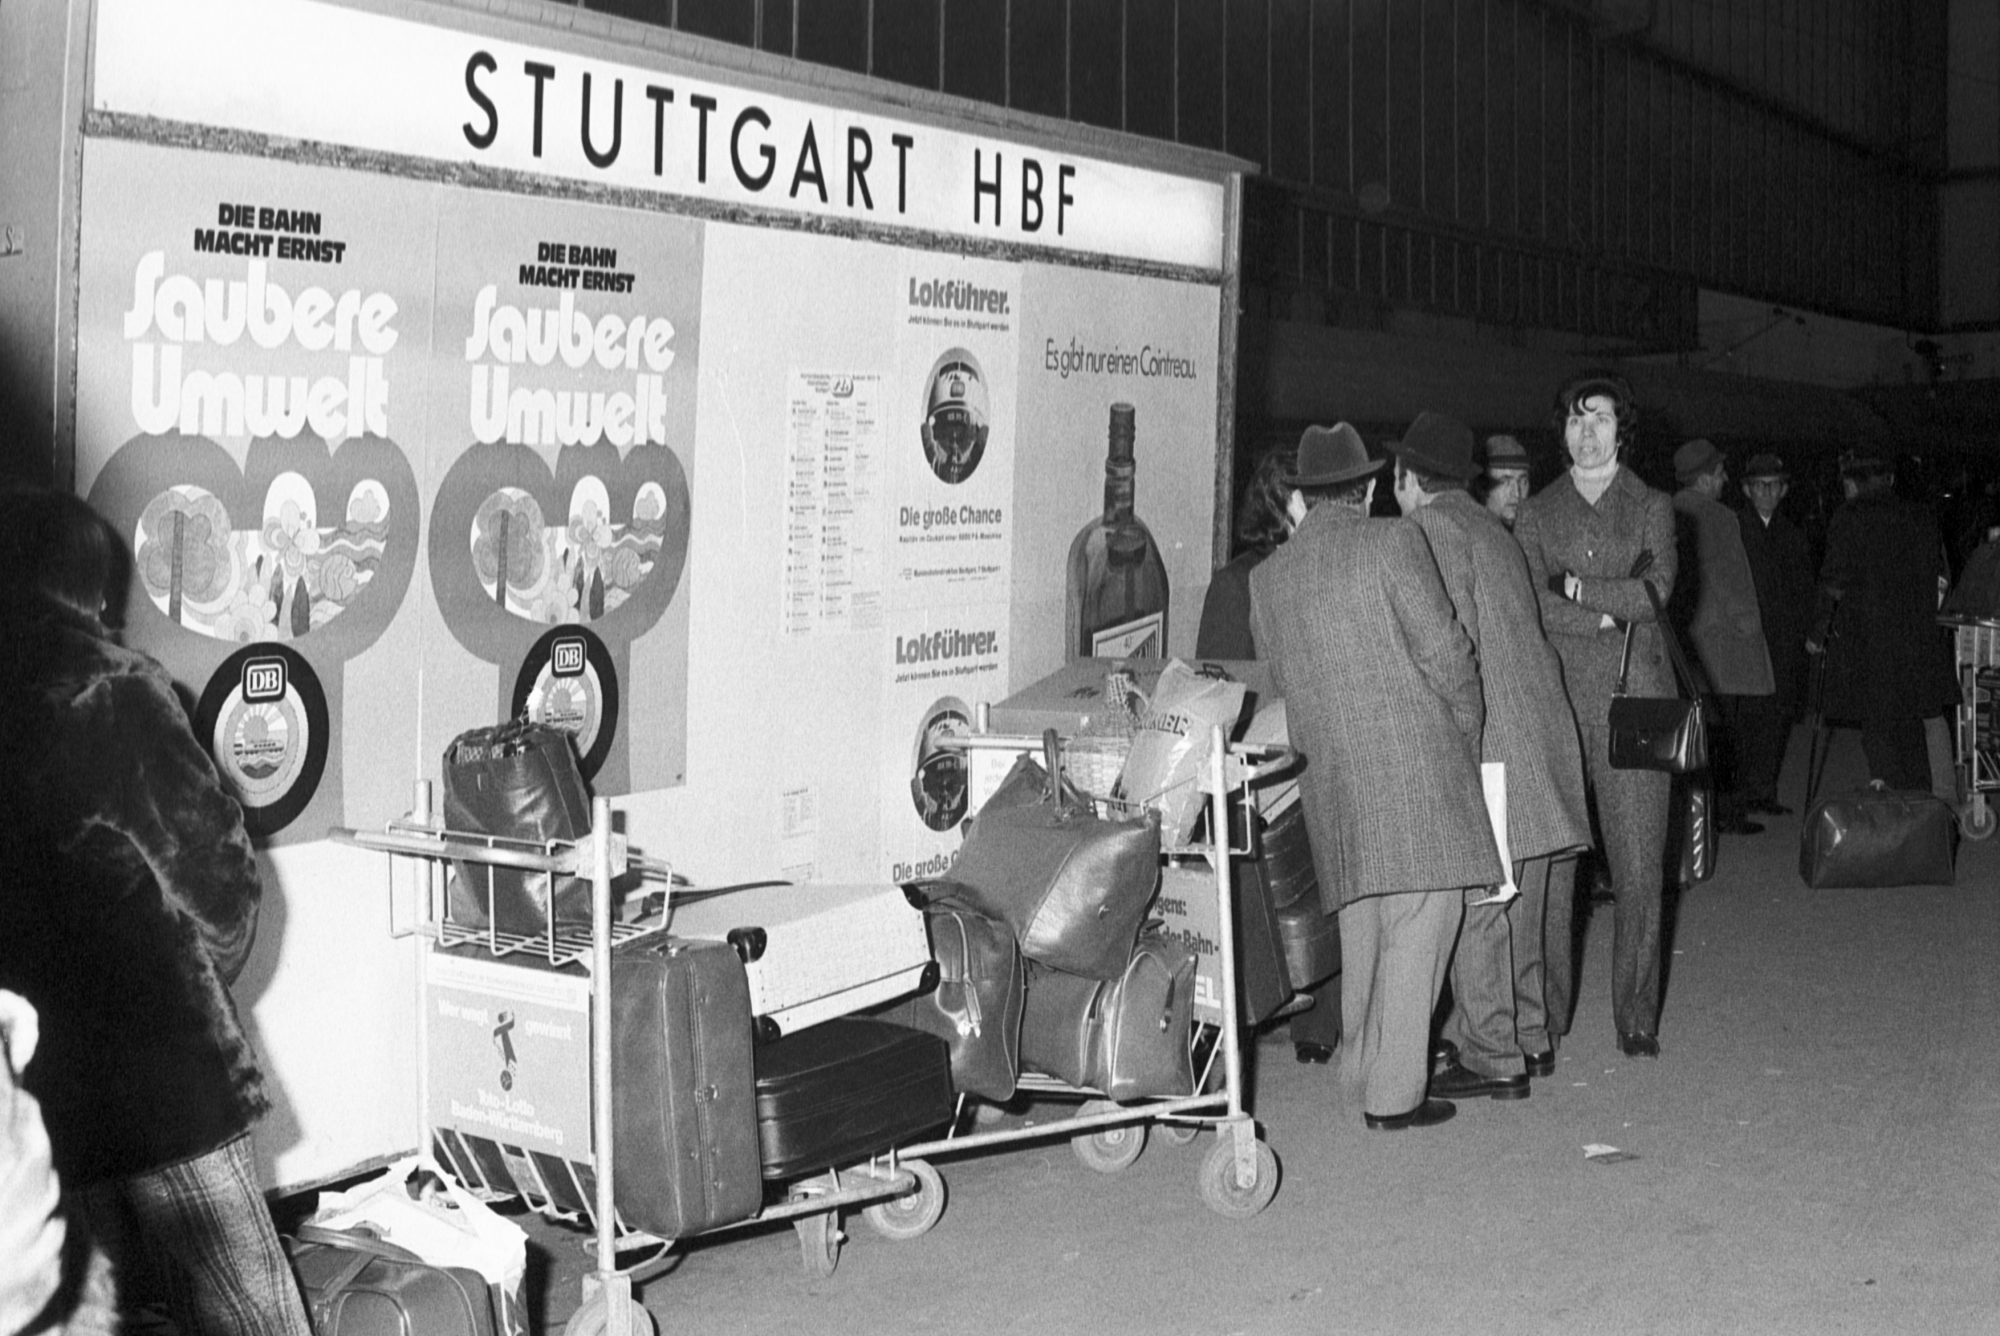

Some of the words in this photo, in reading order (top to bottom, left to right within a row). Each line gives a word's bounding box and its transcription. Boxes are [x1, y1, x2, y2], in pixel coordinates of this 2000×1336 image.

[462, 50, 914, 214] STUTTGART
[974, 148, 1076, 235] HBF
[218, 203, 256, 230] DIE
[258, 208, 322, 235] BAHN
[194, 228, 274, 258] MACHT
[278, 236, 346, 264] ERNST
[537, 242, 566, 265] DIE
[568, 245, 617, 268] BAHN
[519, 264, 580, 289] MACHT
[582, 271, 635, 294] ERNST
[909, 276, 1010, 316] Lokführer.
[123, 250, 399, 355] Saubere
[465, 284, 675, 372] Saubere
[1045, 338, 1059, 371] Es
[1060, 336, 1084, 379] gibt
[1086, 351, 1107, 374] nur
[1107, 345, 1139, 375] einen
[1140, 345, 1197, 380] Cointreau.
[131, 341, 389, 440] Umwelt
[470, 363, 667, 447] Umwelt
[900, 506, 920, 527] Die
[923, 506, 957, 530] große
[959, 505, 1002, 525] Chance
[558, 649, 579, 667] DB
[896, 628, 998, 664] Lokführer.
[251, 670, 278, 691] DB
[893, 862, 913, 882] Die
[915, 853, 949, 881] große
